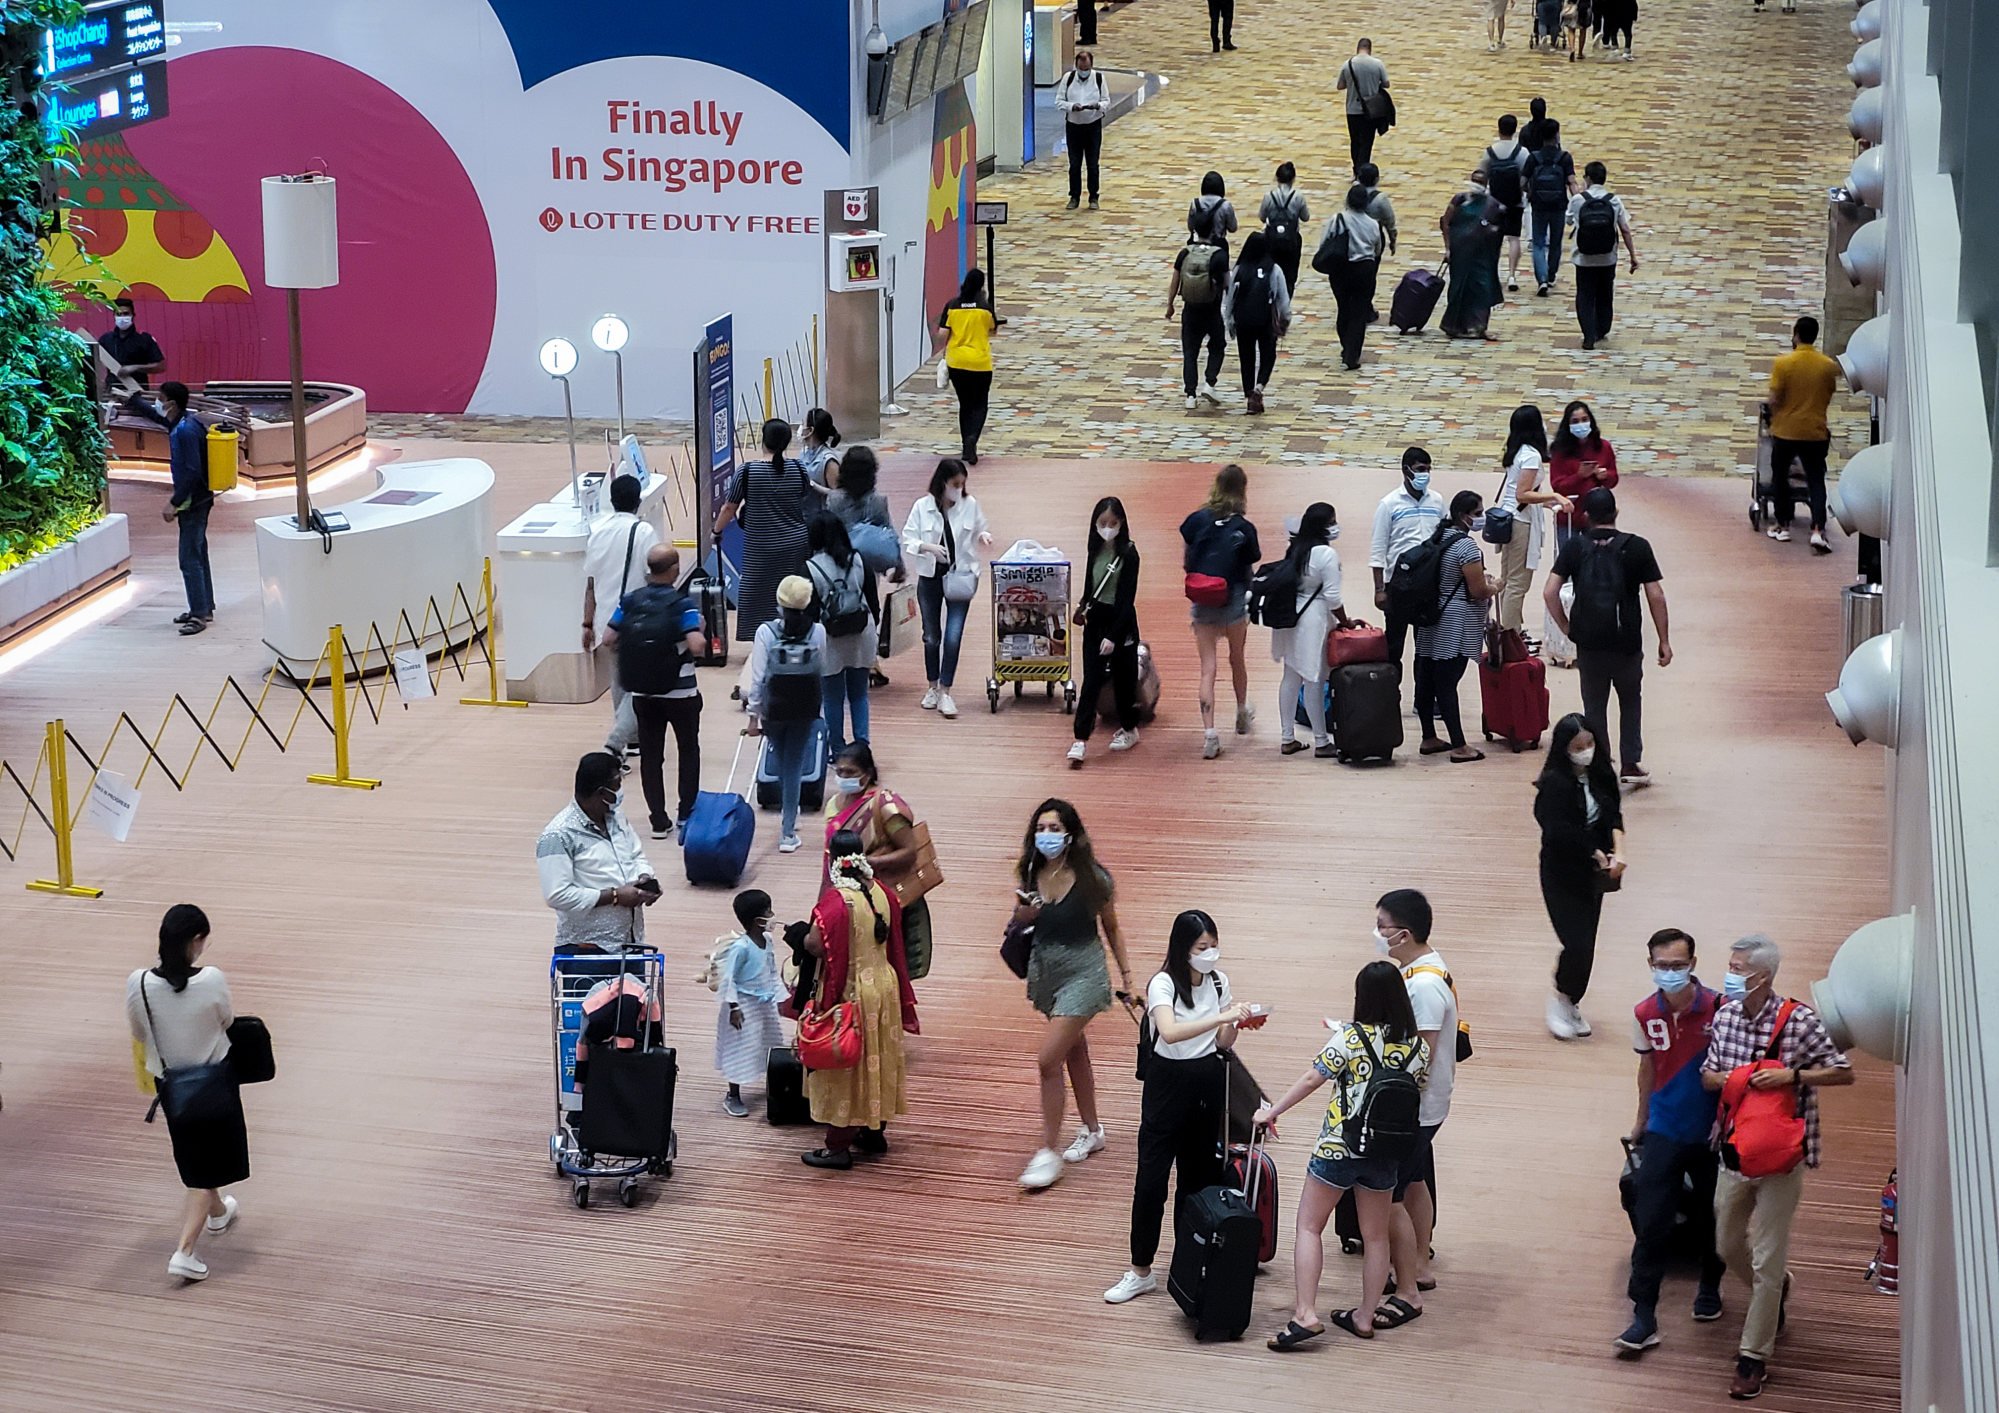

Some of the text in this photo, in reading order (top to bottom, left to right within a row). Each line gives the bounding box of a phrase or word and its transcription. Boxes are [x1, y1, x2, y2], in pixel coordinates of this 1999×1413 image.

[55, 17, 108, 51] iShopChangi
[60, 102, 97, 126] Lounges
[607, 100, 743, 146] Finally
[551, 147, 803, 193] In Singapore
[569, 212, 820, 234] LOTTE DUTY FREE
[709, 341, 729, 364] BINGO!
[1646, 1018, 1671, 1051] 9
